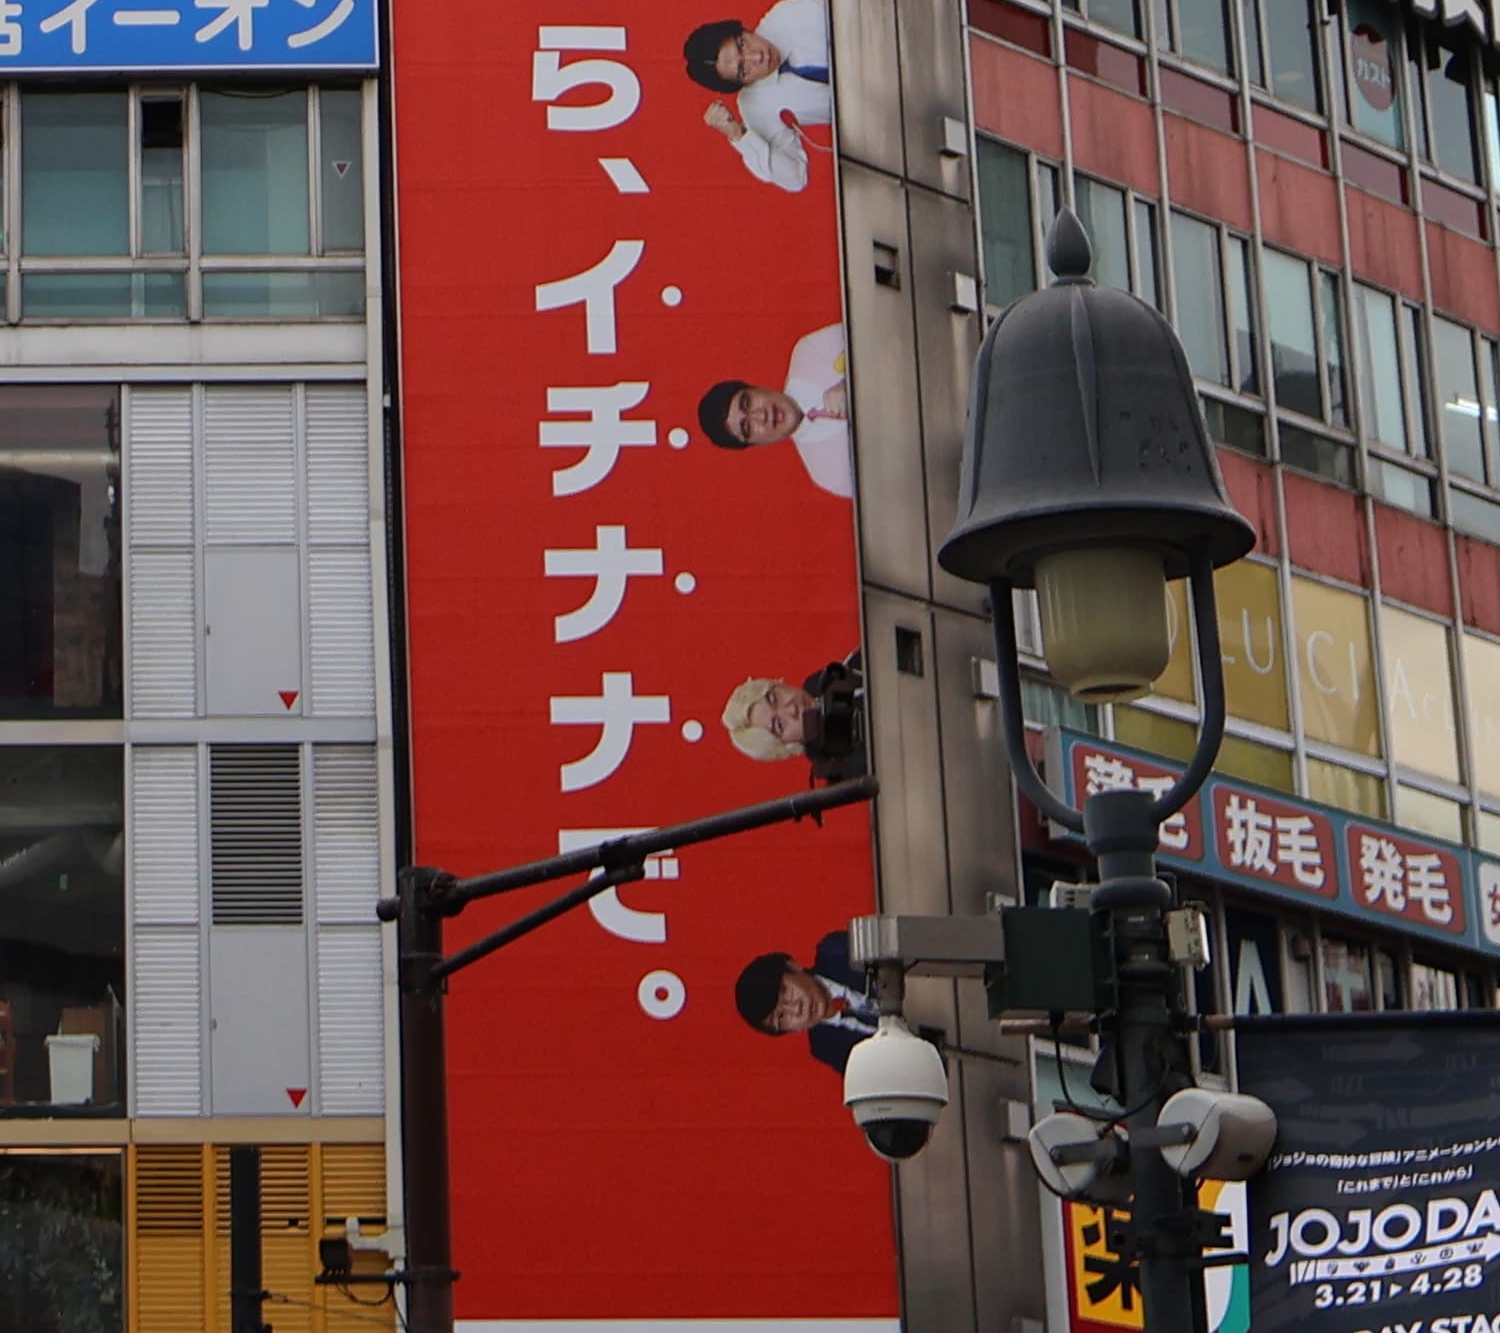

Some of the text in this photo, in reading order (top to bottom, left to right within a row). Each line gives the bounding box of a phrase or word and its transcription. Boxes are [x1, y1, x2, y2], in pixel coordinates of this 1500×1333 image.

[1225, 795, 1325, 889] 抜毛
[1360, 835, 1452, 925] 発毛
[1314, 1264, 1483, 1309] 3.21 4.28
